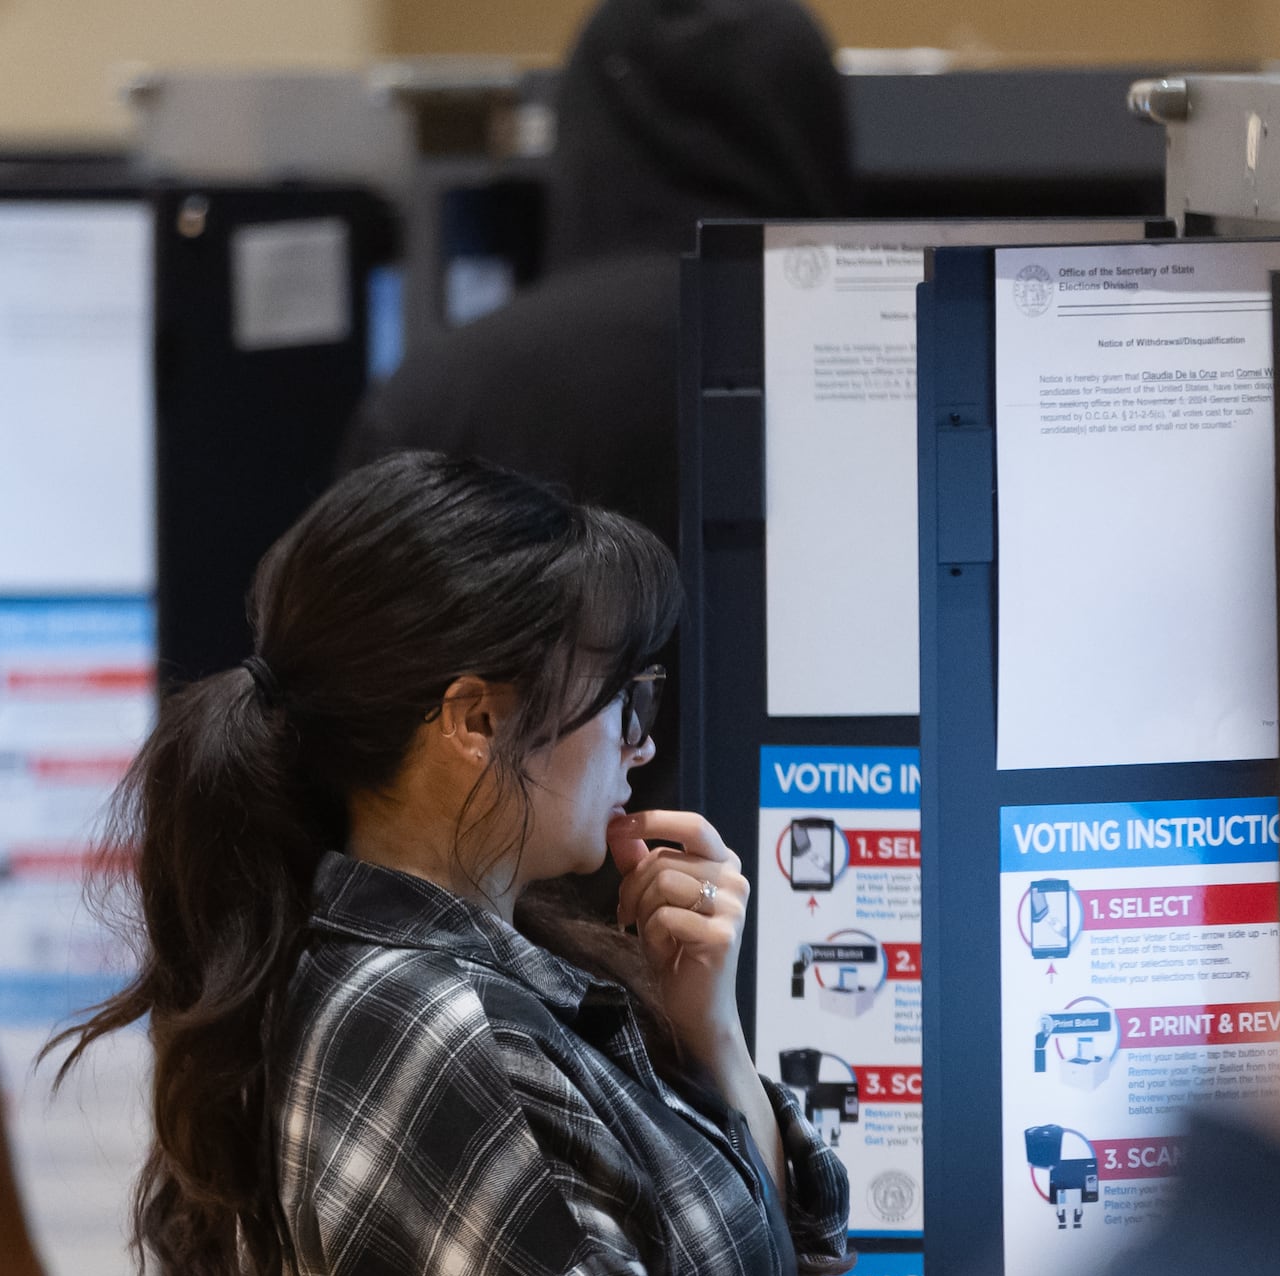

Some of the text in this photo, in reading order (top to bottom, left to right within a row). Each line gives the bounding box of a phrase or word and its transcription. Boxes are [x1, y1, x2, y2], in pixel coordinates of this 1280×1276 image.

[1059, 268, 1087, 277] Office
[1099, 267, 1113, 276] the
[1116, 266, 1157, 277] Secretary
[1171, 265, 1195, 274] State
[1059, 280, 1139, 292] Elections Division
[1098, 339, 1123, 348] Notice
[1136, 335, 1246, 347] Withdrawal/Disqualification
[1039, 375, 1064, 383] Notice
[1074, 375, 1100, 384] hereby
[1102, 374, 1123, 384] given
[1142, 370, 1173, 380] Claudia
[1199, 369, 1218, 378] Cruz
[1220, 369, 1234, 378] and
[1236, 368, 1262, 377] Cornel
[774, 762, 893, 795] VOTING
[1013, 819, 1121, 855] VOTING
[857, 837, 873, 859] 1.
[1089, 895, 1193, 920] 1. SELECT
[1121, 934, 1141, 945] your
[1144, 932, 1168, 943] Voter
[1171, 931, 1190, 942] Card
[1201, 932, 1225, 940] arrow
[1228, 929, 1246, 939] side
[1101, 946, 1116, 955] the
[1118, 945, 1139, 955] base
[1153, 943, 1167, 953] the
[895, 950, 917, 972] 2.
[1091, 959, 1116, 970] Mark
[1119, 960, 1139, 971] your
[1141, 957, 1185, 969] selections
[1091, 973, 1128, 985] Review
[1129, 974, 1149, 986] your
[1151, 971, 1195, 982] selections
[1197, 970, 1209, 981] for
[1127, 1017, 1147, 1038] 2.
[1150, 1013, 1216, 1037] PRINT
[1218, 1012, 1234, 1034] &
[1128, 1052, 1152, 1062] Print
[1154, 1053, 1173, 1064] your
[1223, 1050, 1237, 1059] the
[1238, 1048, 1266, 1058] button
[1128, 1066, 1168, 1077] Remove
[1170, 1067, 1189, 1078] your
[1219, 1063, 1244, 1073] Ballot
[1246, 1062, 1268, 1072] from
[866, 1072, 923, 1095] 3. SC
[1128, 1079, 1145, 1089] and
[1147, 1080, 1168, 1091] your
[1128, 1092, 1164, 1103] Review
[1128, 1105, 1153, 1115] ballot
[1104, 1148, 1123, 1170] 3.
[1104, 1186, 1137, 1196] Return
[1104, 1199, 1131, 1210] Place
[1104, 1215, 1122, 1225] Get
